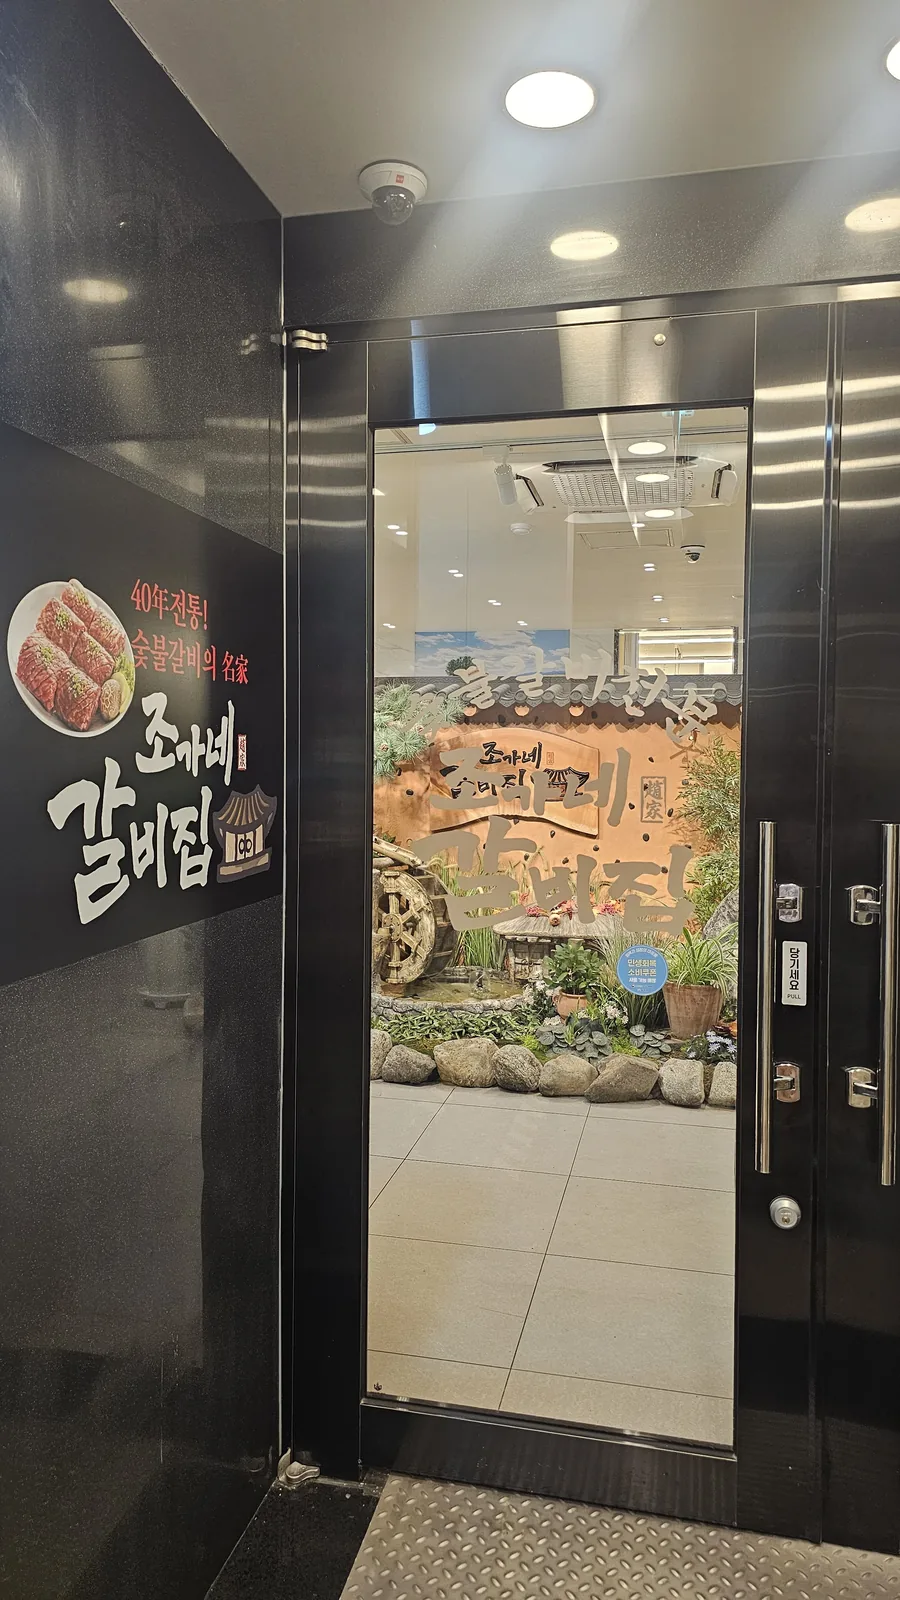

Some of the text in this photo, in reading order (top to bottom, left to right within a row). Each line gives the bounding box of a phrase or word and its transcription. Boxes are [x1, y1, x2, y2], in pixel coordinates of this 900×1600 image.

[131, 628, 249, 684] 숯불갈비의 名家
[135, 692, 235, 786] 조가네
[479, 741, 543, 769] 조가네
[429, 746, 632, 827] 조가네
[47, 756, 213, 925] 갈비집
[409, 815, 697, 937] 갈비집
[627, 959, 657, 967] 민생회복
[627, 968, 657, 977] 소비쿠폰
[789, 947, 801, 990] 당기세요
